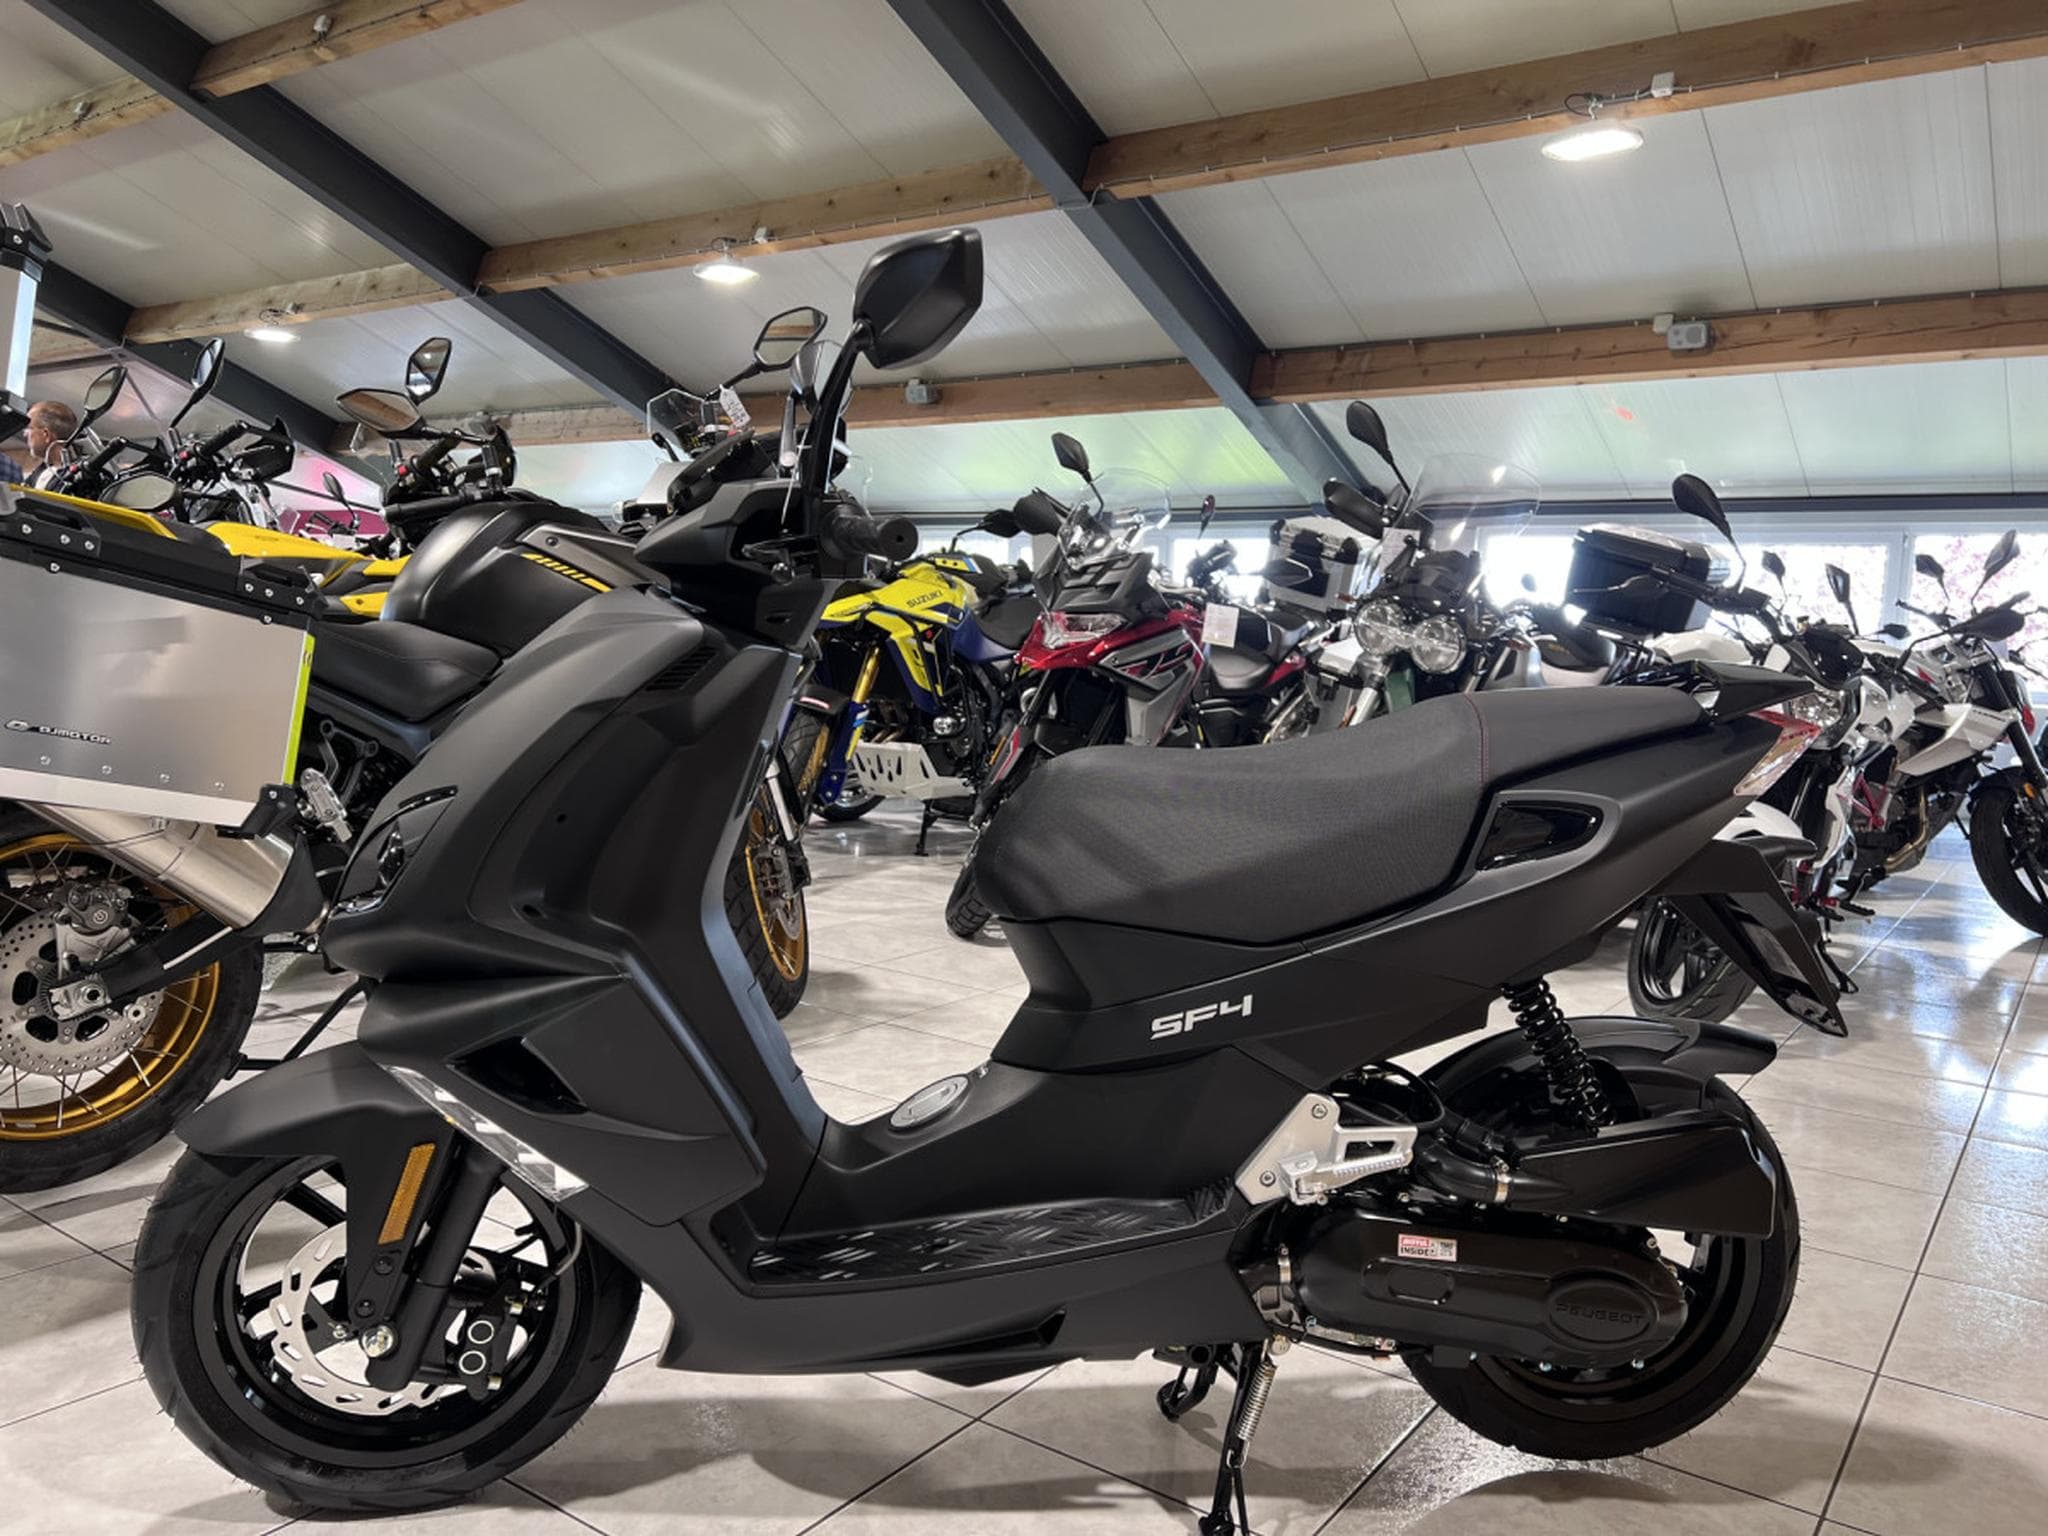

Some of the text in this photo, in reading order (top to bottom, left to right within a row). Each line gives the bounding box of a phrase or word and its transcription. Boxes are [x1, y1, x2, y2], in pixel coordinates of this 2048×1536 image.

[906, 589, 943, 608] SUZUKI
[1150, 994, 1253, 1040] SF4
[1400, 1246, 1429, 1257] INSIDE
[1555, 1303, 1643, 1325] PEUGEOT
